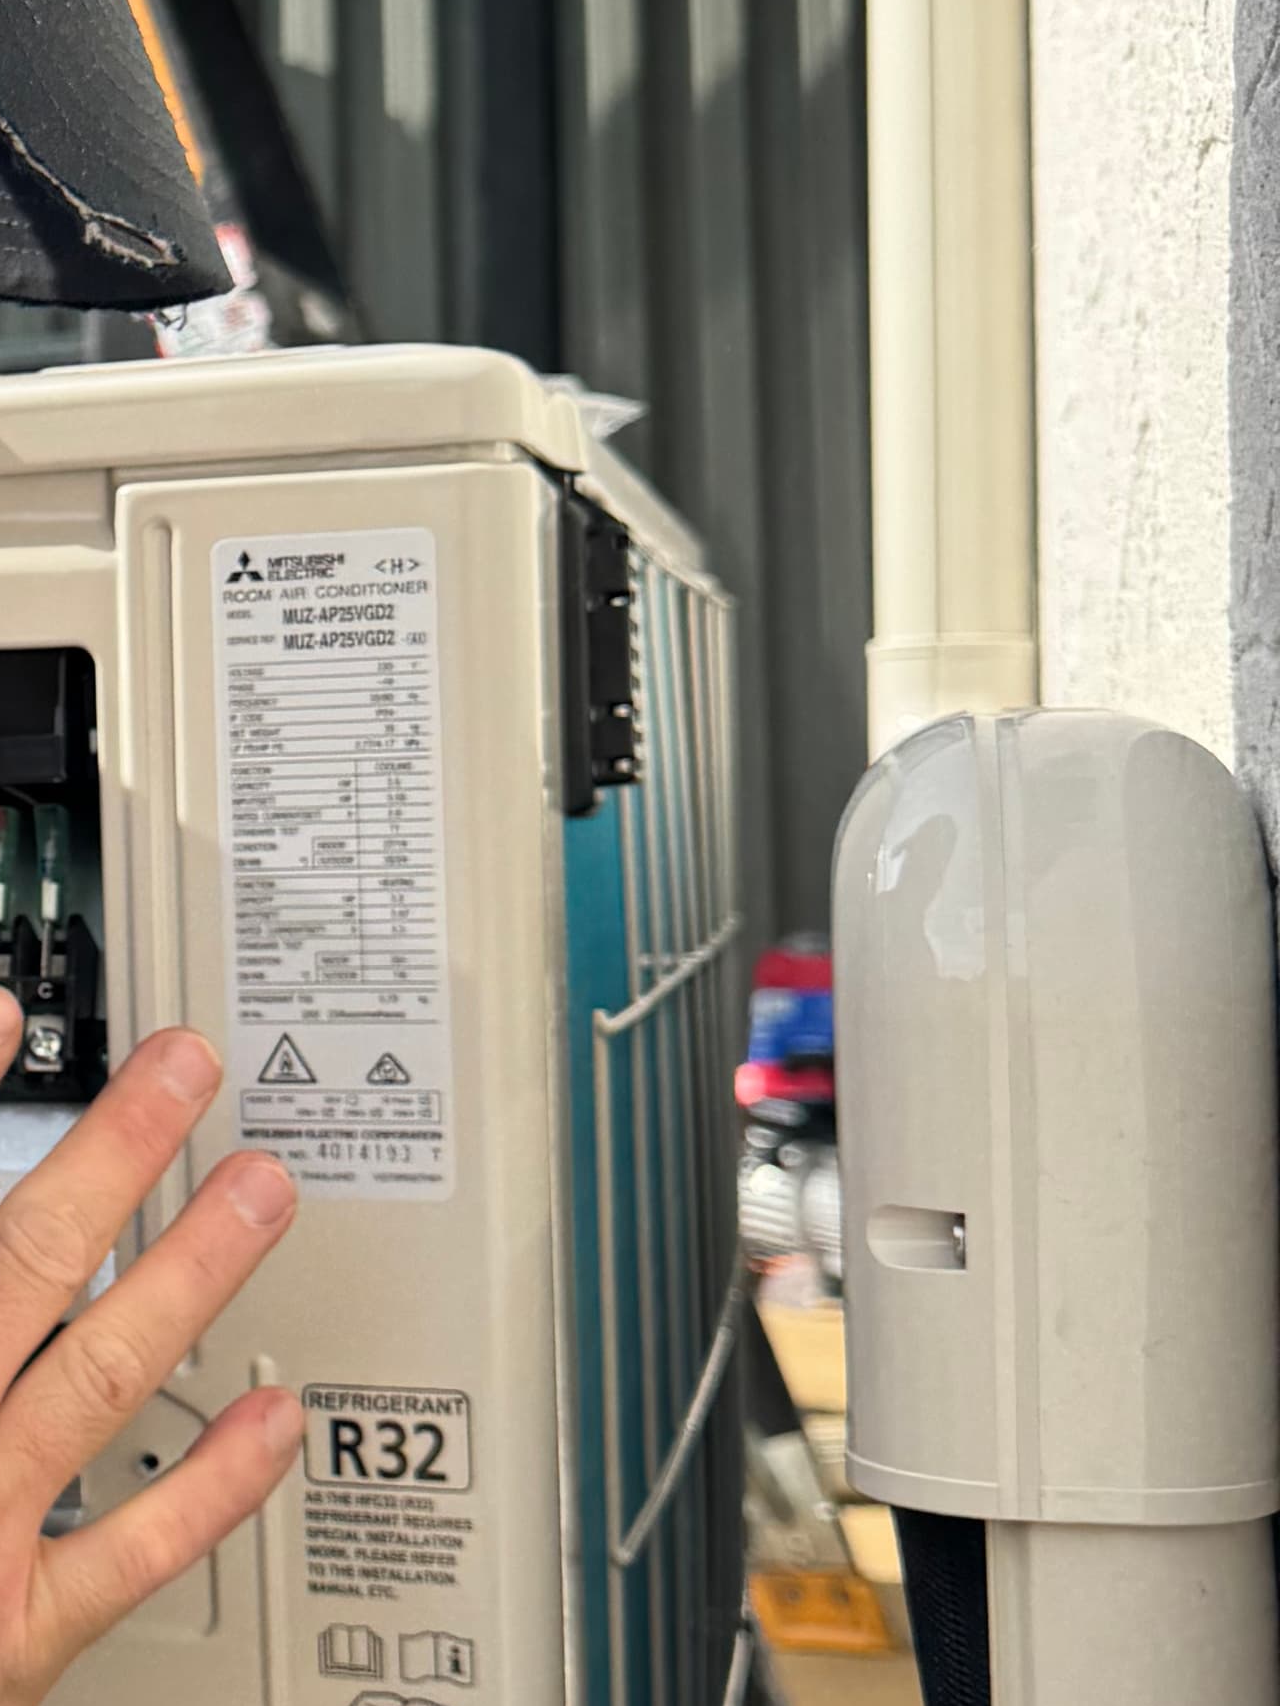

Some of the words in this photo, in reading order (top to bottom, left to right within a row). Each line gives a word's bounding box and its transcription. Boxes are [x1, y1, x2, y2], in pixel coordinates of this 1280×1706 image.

[267, 553, 345, 569] MITSUBISHI
[268, 568, 335, 581] ELECTRIC
[280, 586, 306, 600] AIR
[315, 580, 428, 599] CONDITIONER
[37, 985, 53, 998] C
[308, 1391, 465, 1415] REFRIGERANT
[330, 1419, 447, 1482] R32
